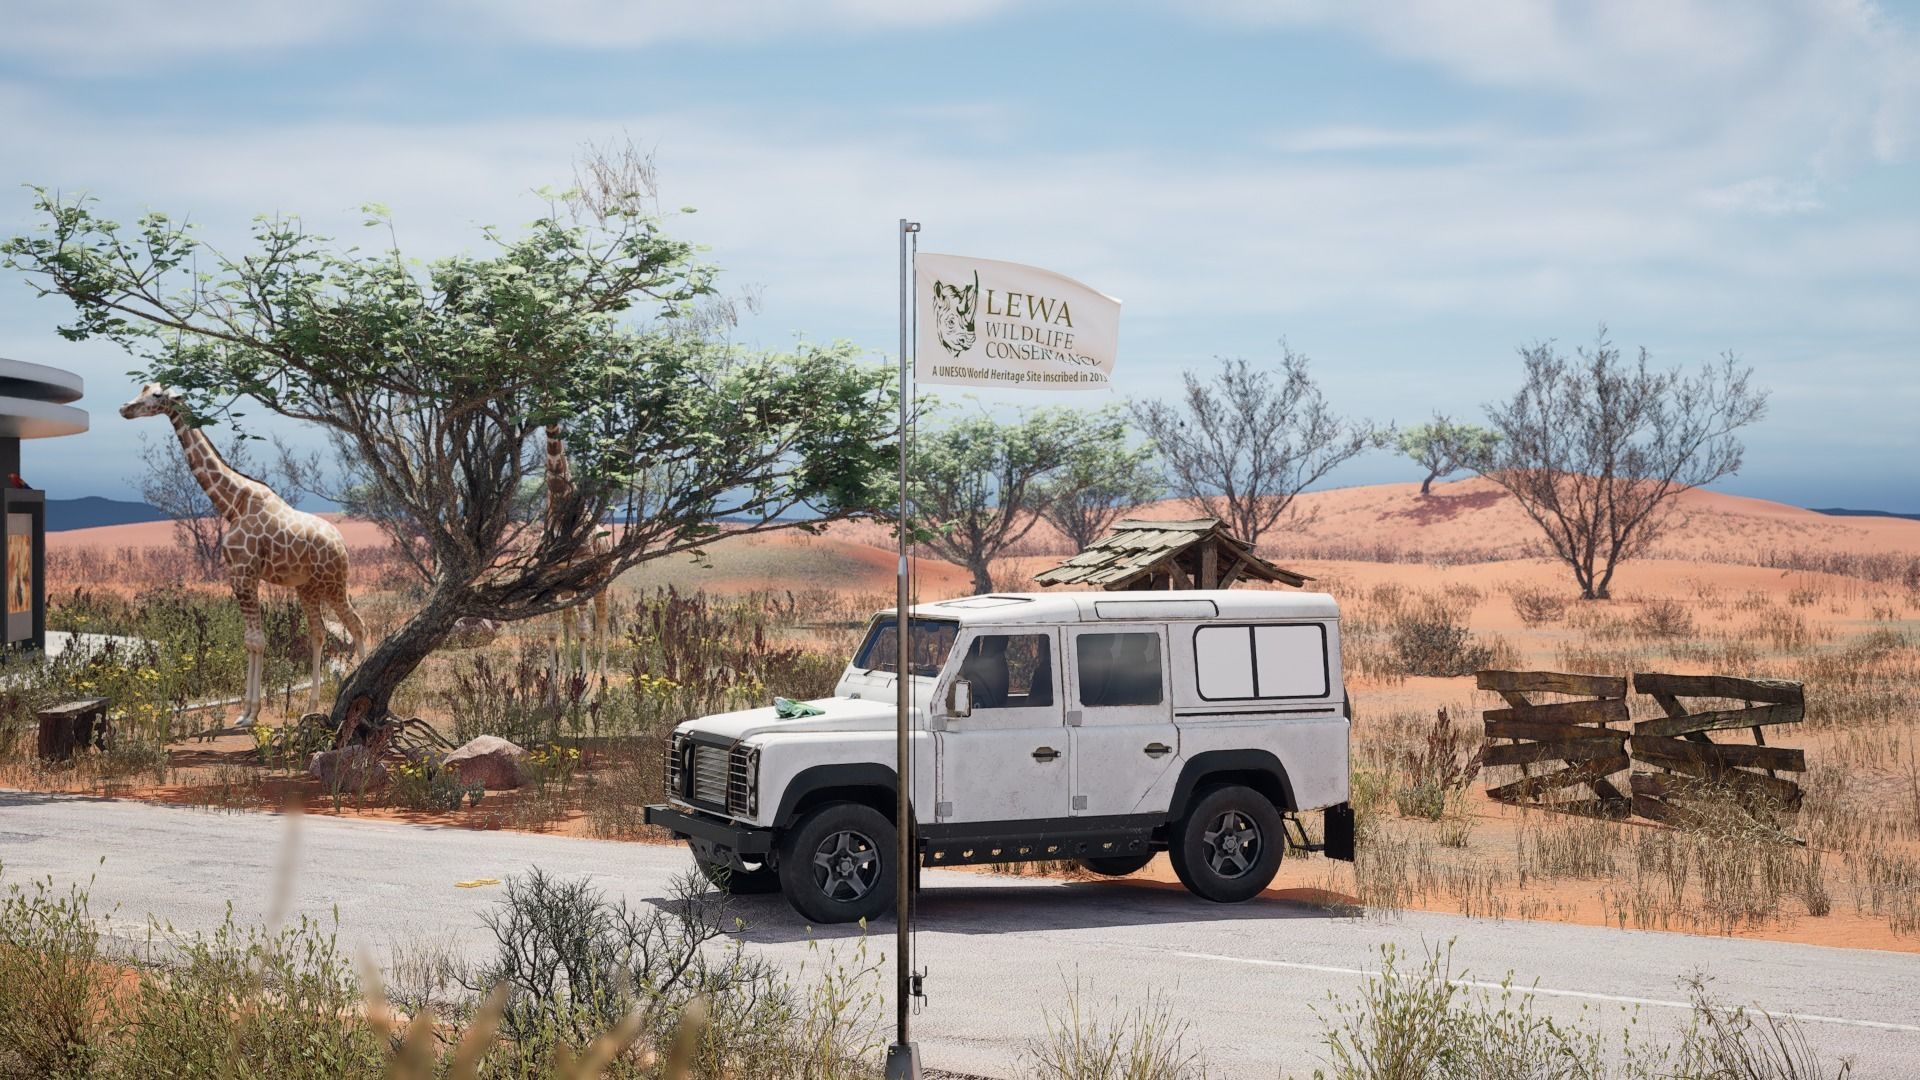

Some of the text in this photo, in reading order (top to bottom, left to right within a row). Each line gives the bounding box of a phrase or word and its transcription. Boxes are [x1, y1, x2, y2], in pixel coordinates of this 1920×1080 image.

[986, 288, 1073, 328] LEWA
[986, 321, 1075, 349] WILDLIFE
[932, 365, 938, 376] A
[939, 365, 967, 378] UNESCO
[967, 367, 989, 379] World
[991, 368, 1025, 383] Heritage
[1026, 370, 1042, 382] Site
[1043, 371, 1079, 382] inscribed
[1080, 371, 1088, 382] in
